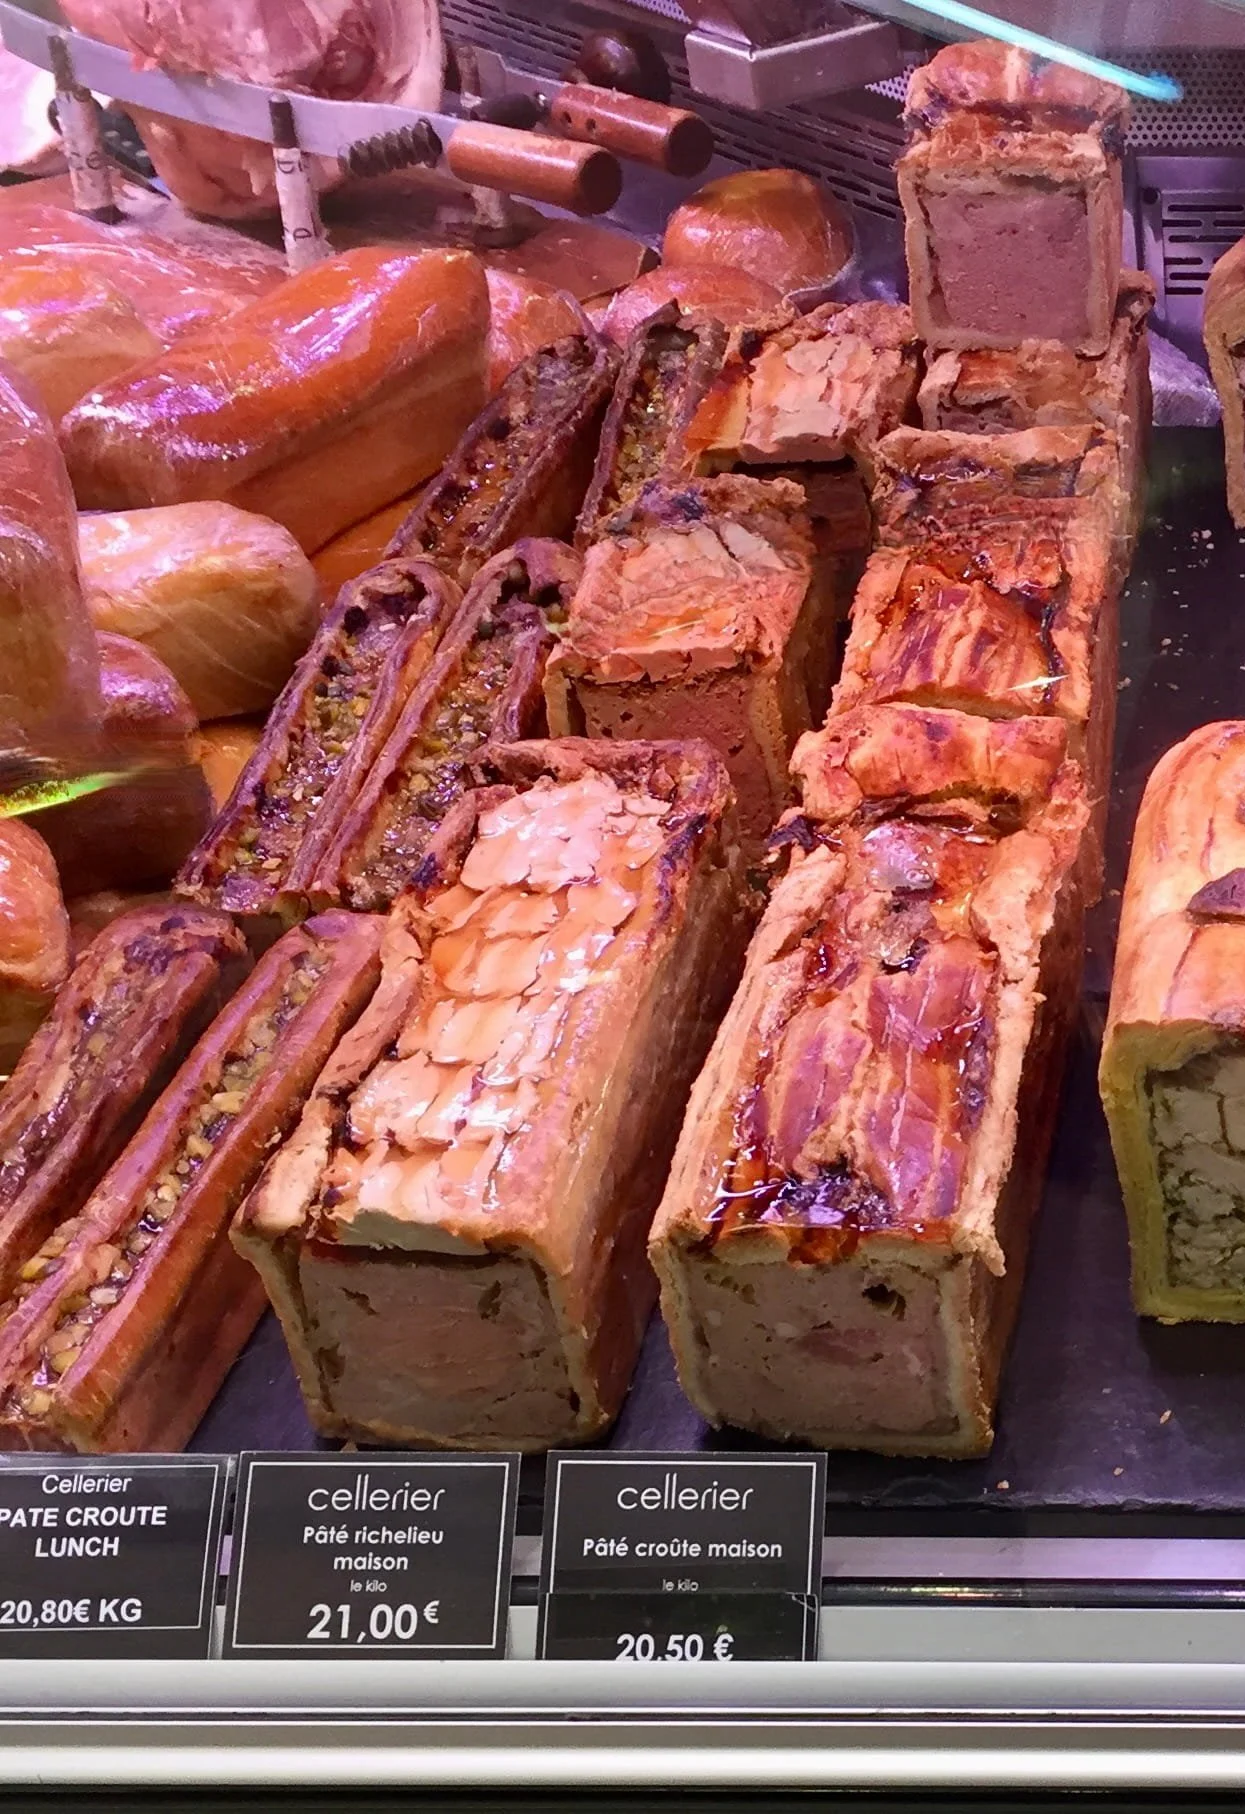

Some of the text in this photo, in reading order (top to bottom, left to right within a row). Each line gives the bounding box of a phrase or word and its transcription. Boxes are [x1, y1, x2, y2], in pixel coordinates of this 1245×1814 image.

[42, 1472, 132, 1493] Cellerier
[308, 1474, 445, 1510] cellerier
[618, 1473, 753, 1510] cellerier
[0, 1506, 167, 1527] PATE CROUTE
[304, 1525, 443, 1544] Pâté richelieu
[35, 1537, 119, 1557] LUNCH
[584, 1537, 781, 1557] Pâté croûte maison
[334, 1552, 408, 1570] maison
[350, 1579, 388, 1593] le kilo
[662, 1579, 699, 1592] le kilo
[0, 1598, 141, 1627] 20,80€ KG
[714, 1633, 733, 1660] €
